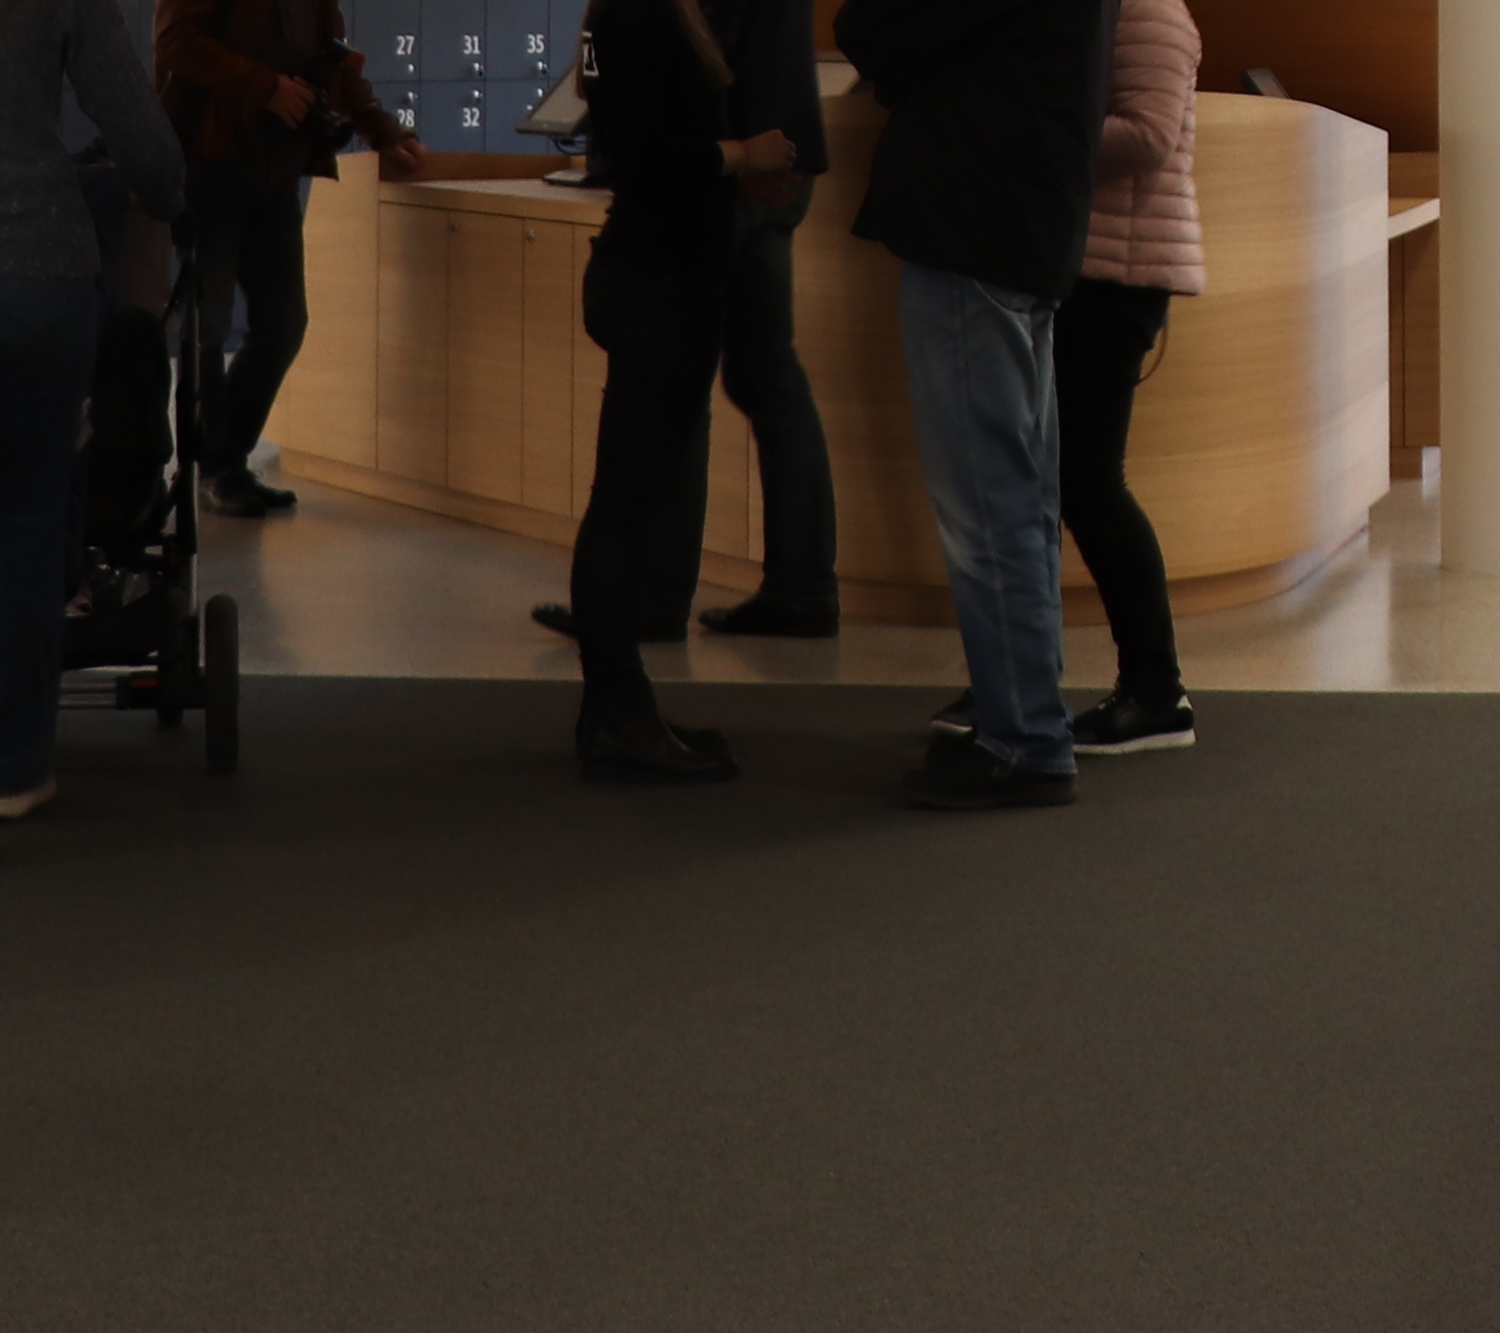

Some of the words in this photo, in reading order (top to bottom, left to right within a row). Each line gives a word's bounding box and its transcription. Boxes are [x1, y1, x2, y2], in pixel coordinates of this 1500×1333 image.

[396, 35, 415, 55] 27
[463, 35, 481, 55] 31
[527, 34, 545, 54] 35
[398, 109, 415, 129] 28
[462, 108, 480, 128] 32
